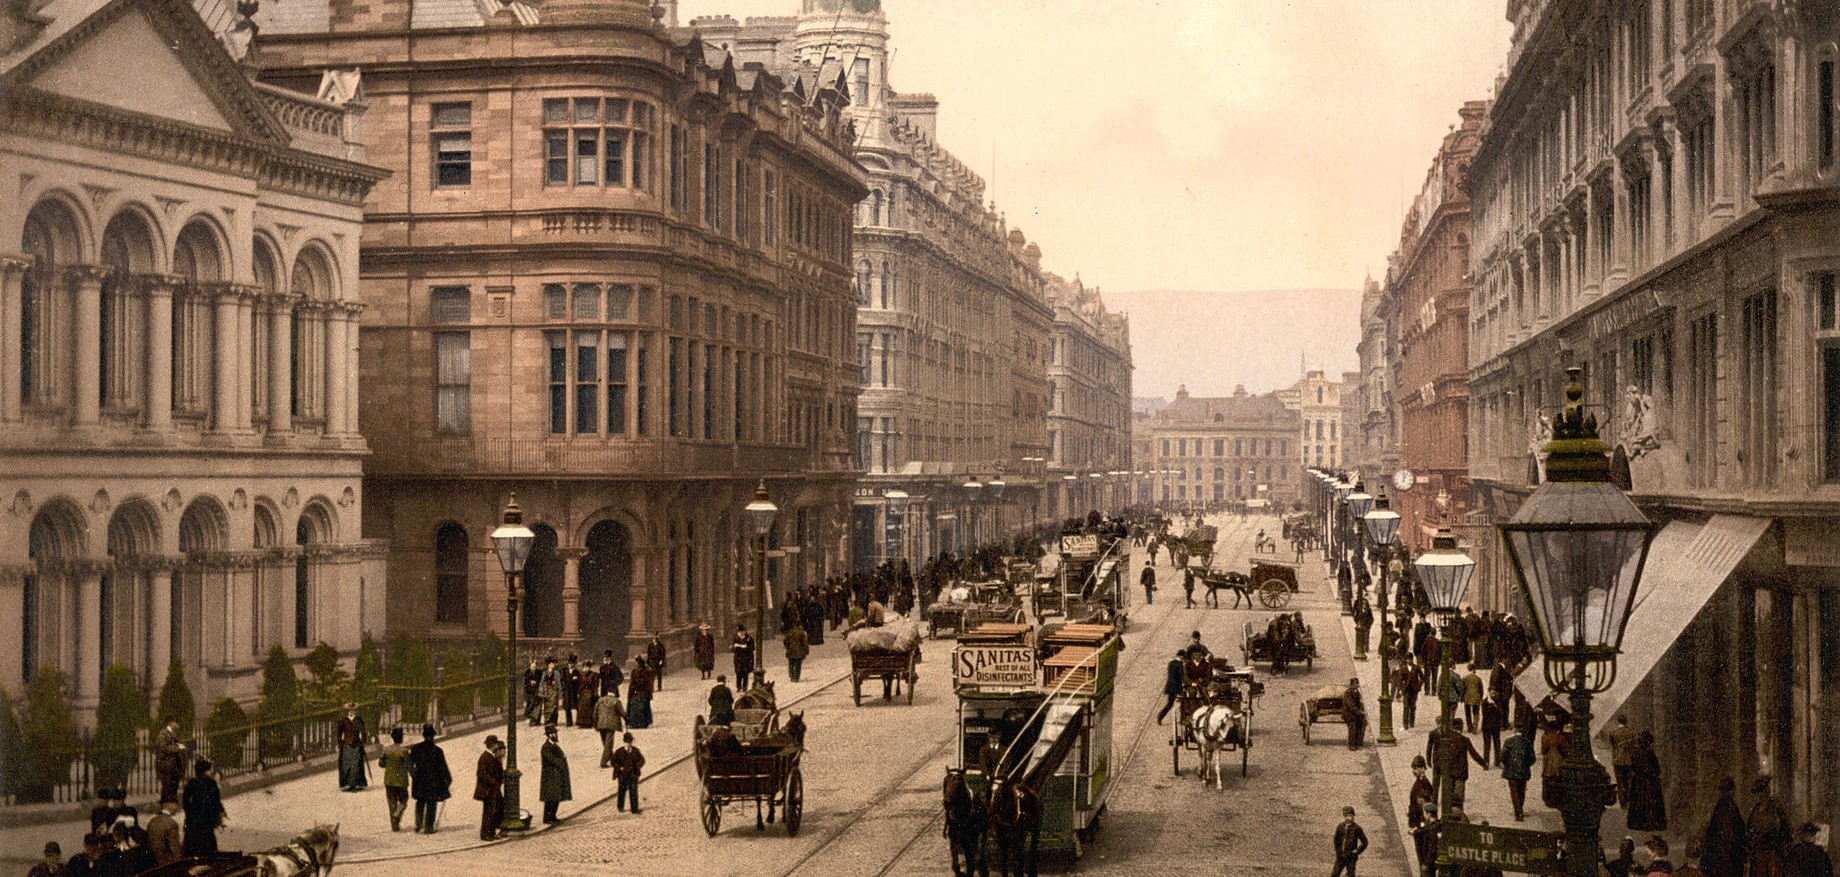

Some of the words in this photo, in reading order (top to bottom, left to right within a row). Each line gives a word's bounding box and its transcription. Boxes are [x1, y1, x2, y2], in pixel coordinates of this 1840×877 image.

[960, 650, 1031, 678] SANITAS
[976, 671, 1033, 682] DISINFECTANTS
[1480, 832, 1494, 844] TO
[1448, 846, 1488, 862] CASTLE
[1491, 850, 1526, 867] PLACE
